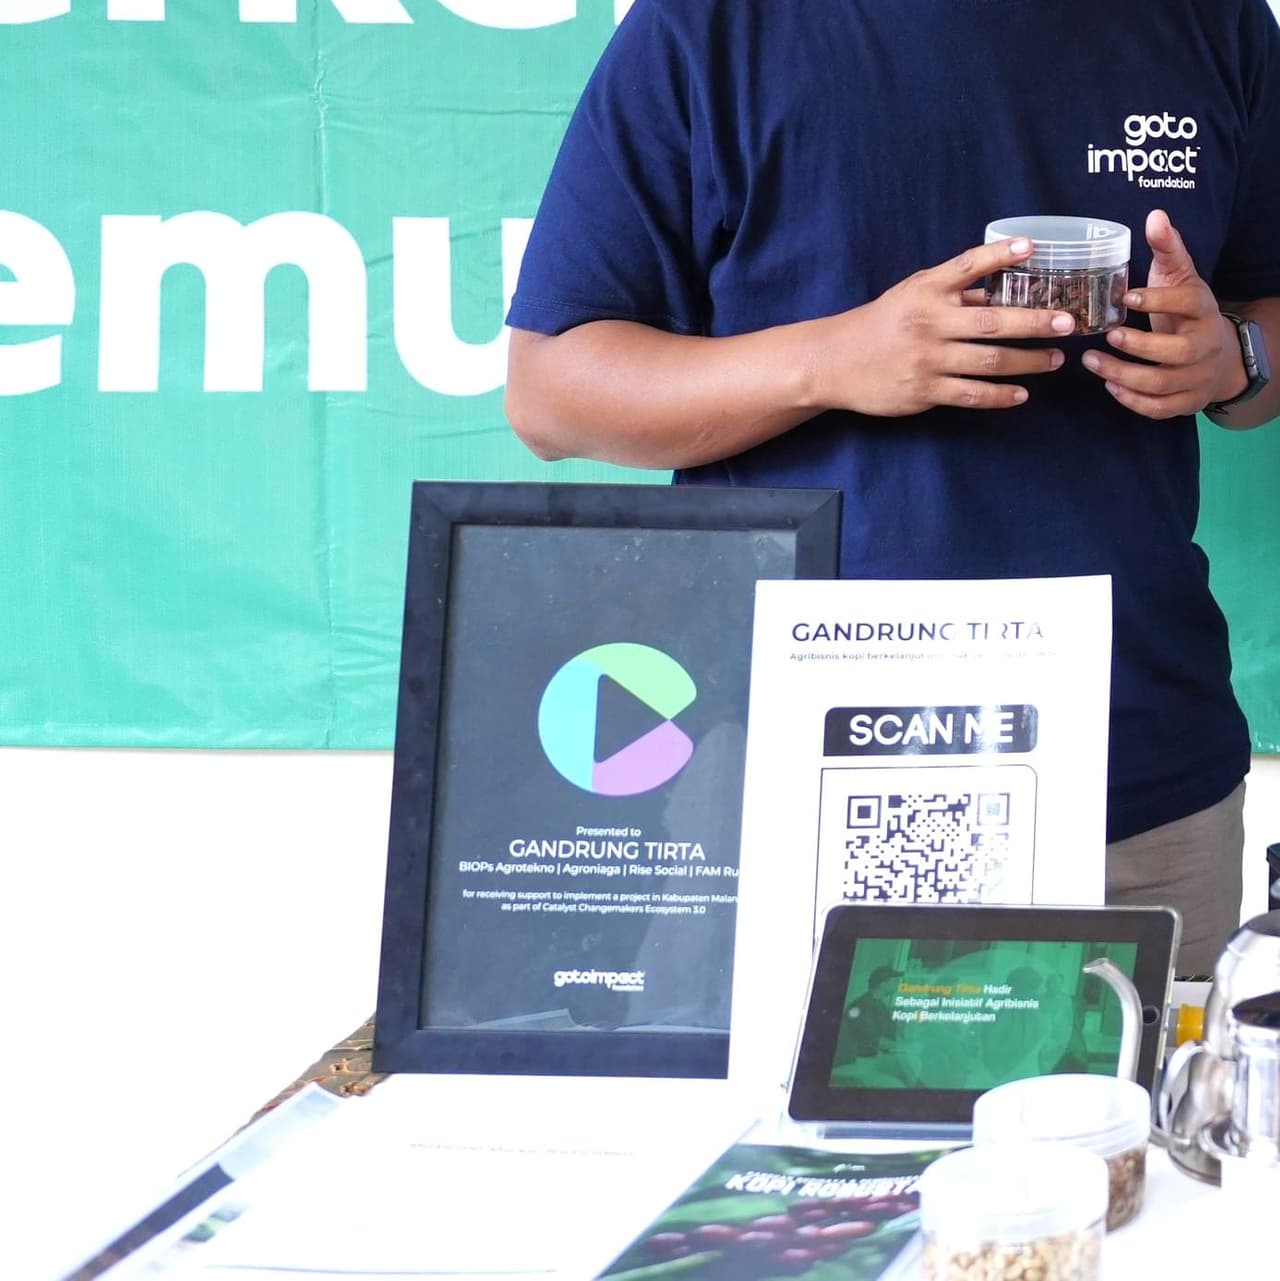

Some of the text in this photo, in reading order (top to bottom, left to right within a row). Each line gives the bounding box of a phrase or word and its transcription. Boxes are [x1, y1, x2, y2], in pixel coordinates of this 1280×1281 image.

[1123, 111, 1198, 146] goto
[1087, 143, 1200, 182] impact
[1137, 175, 1196, 190] foundation
[791, 621, 955, 642] GANDRUNG
[789, 652, 840, 662] Agribisnis
[842, 652, 864, 662] kopi
[866, 651, 942, 661] berkelanjut
[849, 712, 955, 746] SCAN
[575, 825, 642, 838] Presented to
[508, 838, 706, 861] GANDRUNG TIRTA
[458, 860, 494, 873] BIOPs
[495, 861, 555, 875] Agrotekno
[562, 863, 621, 877] Agroniaga
[629, 864, 653, 876] Rise
[654, 864, 688, 877] Social
[695, 865, 725, 877] FAM
[462, 888, 475, 898] for
[476, 889, 516, 900] receiving
[517, 890, 551, 901] support
[563, 891, 611, 903] implement
[620, 892, 650, 904] project
[662, 893, 710, 905] Kabupaten
[512, 902, 532, 913] part
[542, 901, 578, 914] Catalyst
[578, 902, 644, 915] Changemakers
[645, 904, 692, 915] Ecosystem
[692, 905, 706, 914] 3.0
[983, 983, 1013, 995] Hadir
[894, 996, 1040, 1011] Sebagai Inisiatif Agribisnis
[892, 1010, 997, 1024] Kopi Berkelanjutan
[724, 1173, 796, 1196] KOPI
